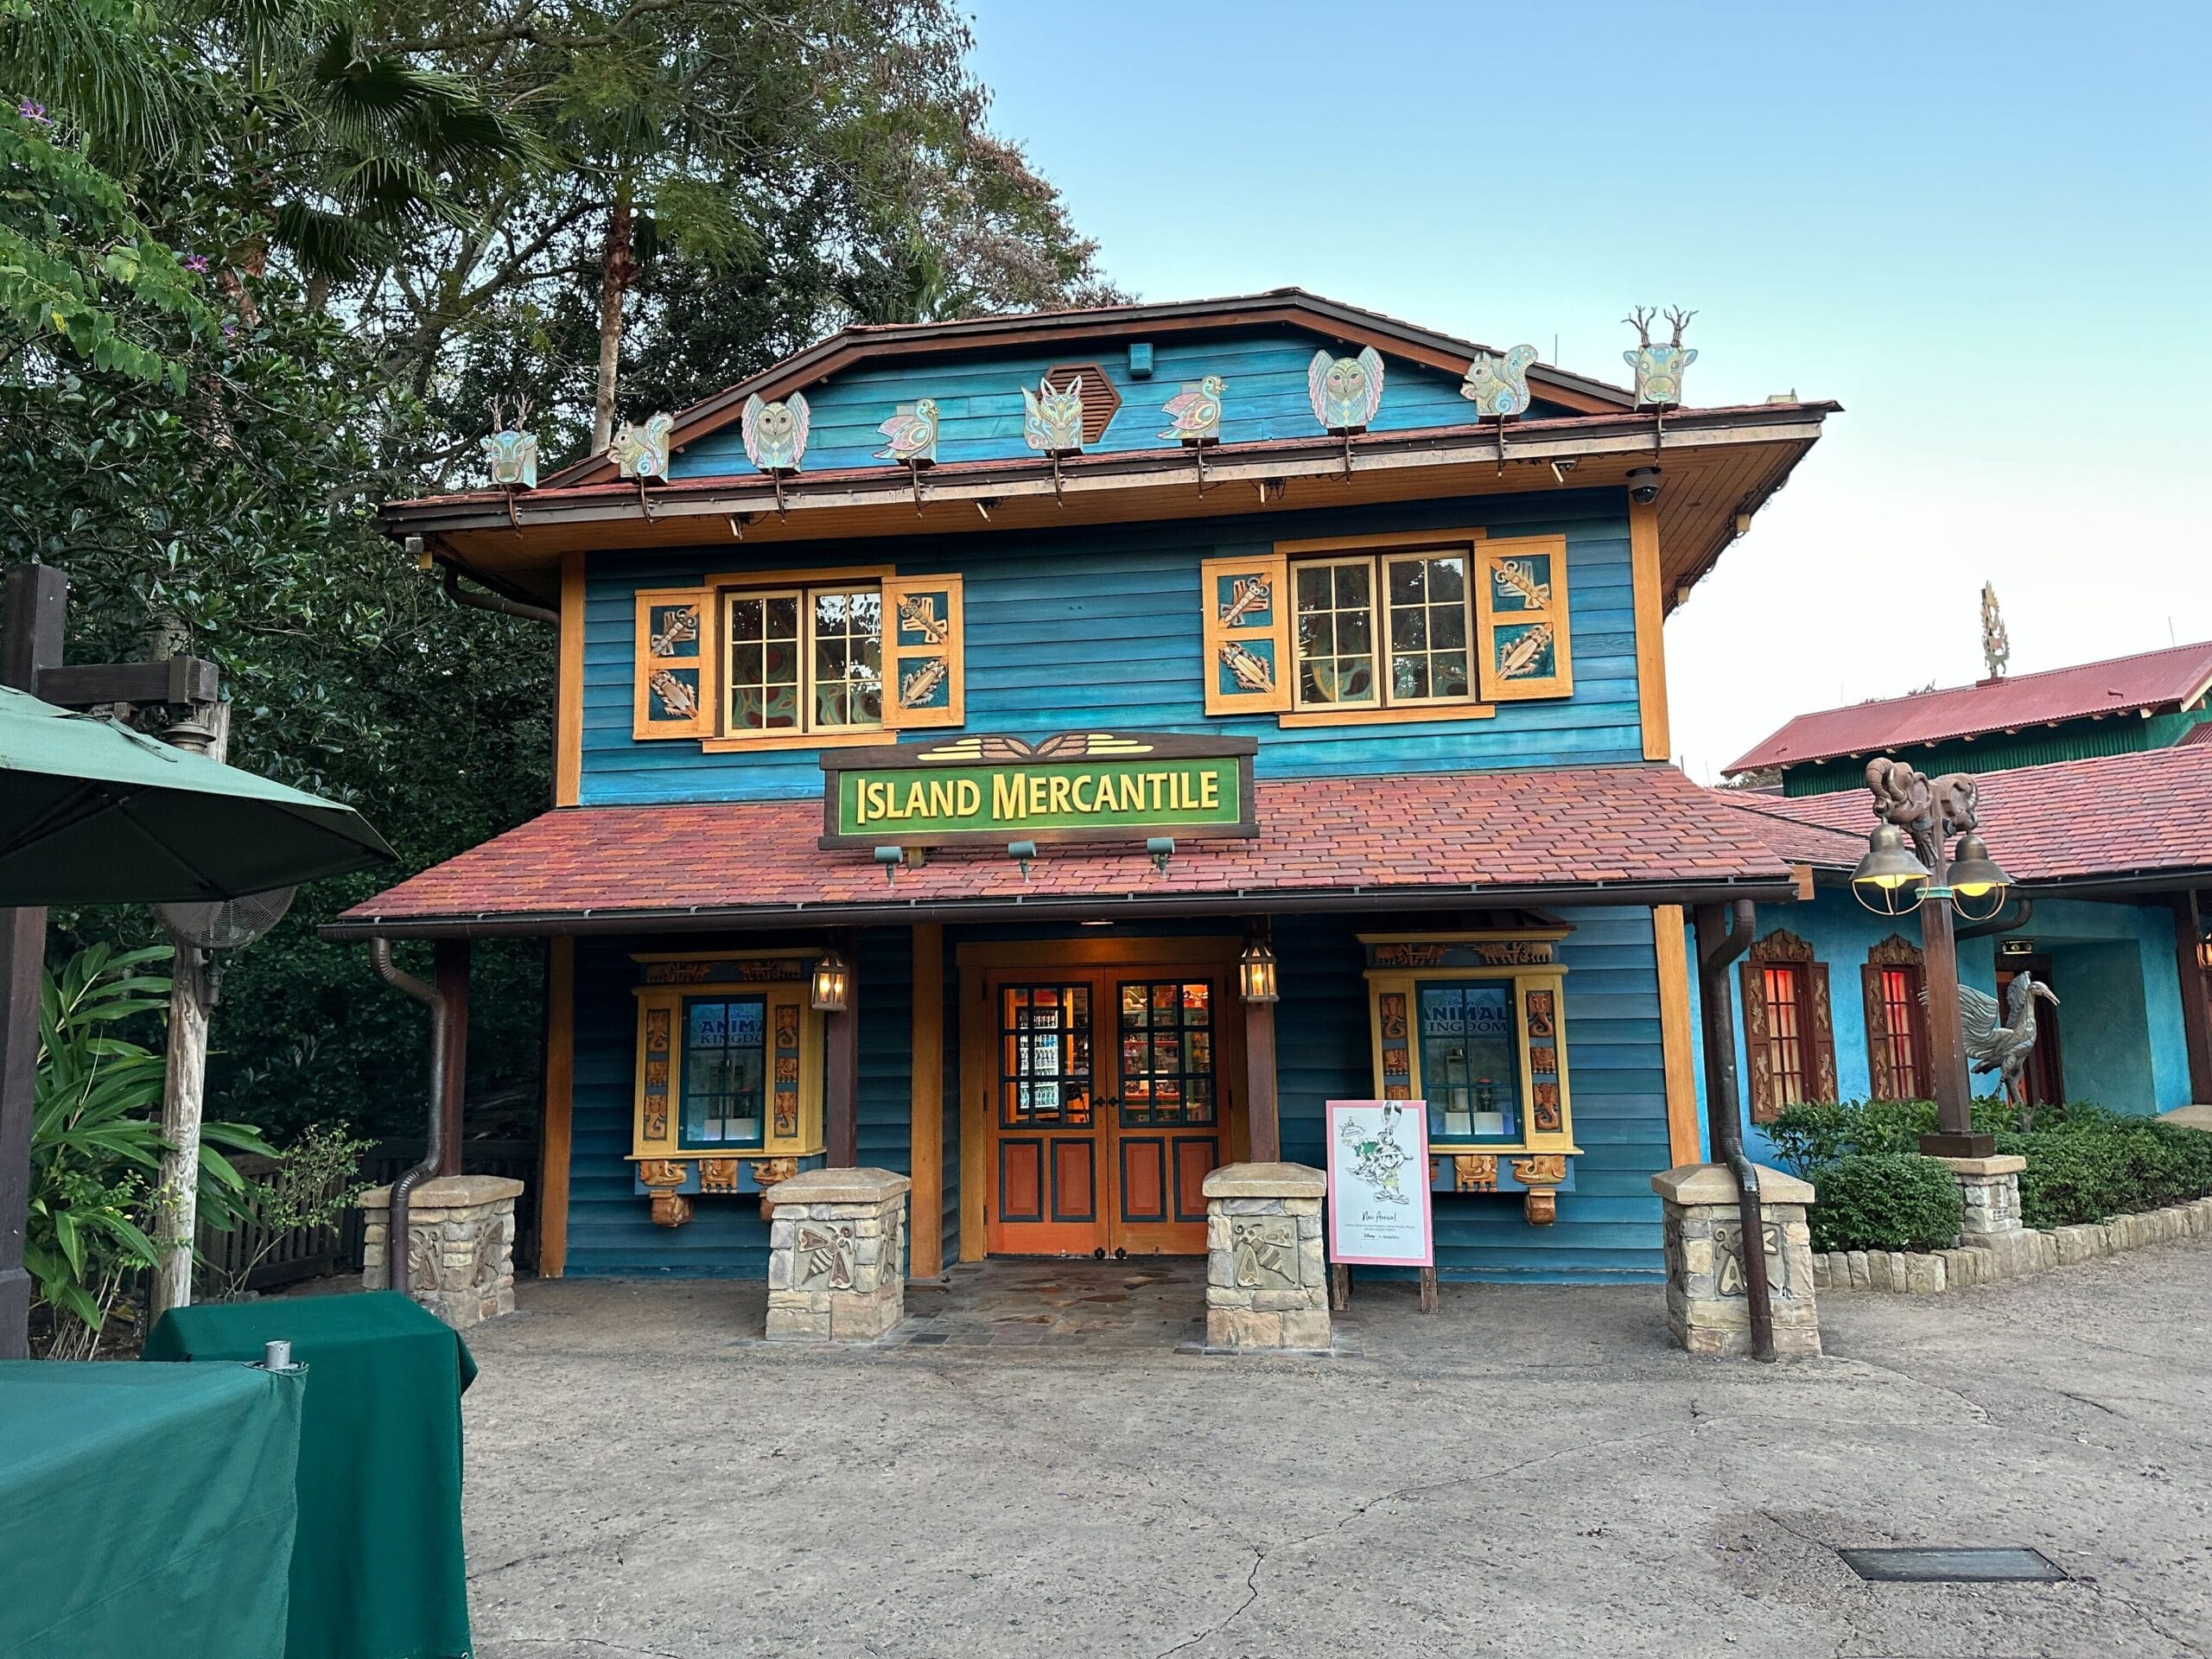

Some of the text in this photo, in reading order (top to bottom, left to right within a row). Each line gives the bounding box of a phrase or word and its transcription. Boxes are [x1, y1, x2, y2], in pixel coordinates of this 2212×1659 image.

[856, 771, 1219, 824] ISLAND MERCANTILE
[1425, 1021, 1507, 1032] INGDOM
